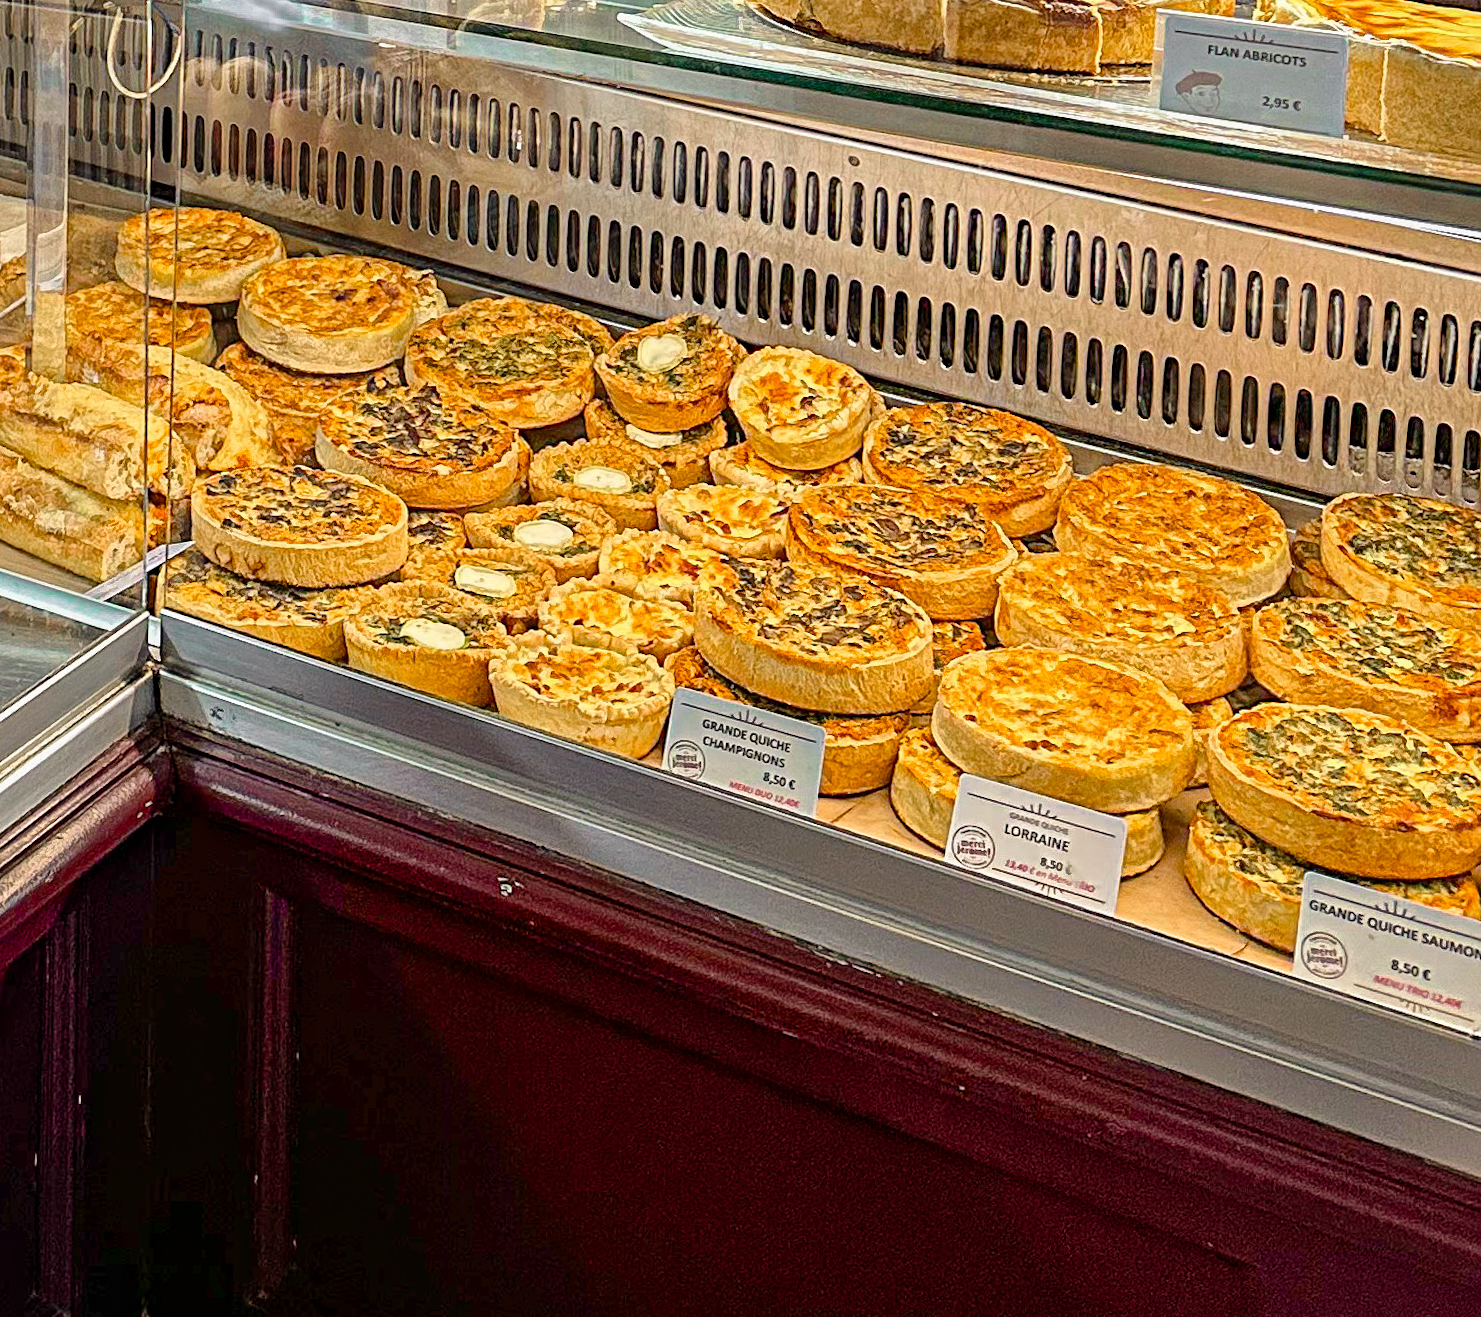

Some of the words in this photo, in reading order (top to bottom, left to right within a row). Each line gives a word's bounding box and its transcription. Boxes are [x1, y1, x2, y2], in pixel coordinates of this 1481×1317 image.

[1207, 45, 1240, 58] FLAN
[1243, 49, 1307, 67] ABRICOTS
[1262, 96, 1290, 110] 2,95
[1292, 100, 1302, 112] €
[702, 719, 748, 740] GRANDE
[749, 732, 792, 753] QUICHE
[702, 736, 786, 768] CHAMPIGNONS
[729, 781, 754, 794] MENU
[754, 789, 773, 800] DUO
[763, 772, 787, 787] 8,50
[789, 779, 796, 790] €
[1004, 823, 1070, 853] LORRAINE
[1036, 870, 1047, 878] en
[1040, 857, 1063, 871] 8,50
[1309, 899, 1364, 925] GRANDE
[1367, 917, 1418, 941] QUICHE
[1391, 959, 1419, 977] 8,50
[1422, 969, 1431, 981] €
[1374, 975, 1405, 991] MENU
